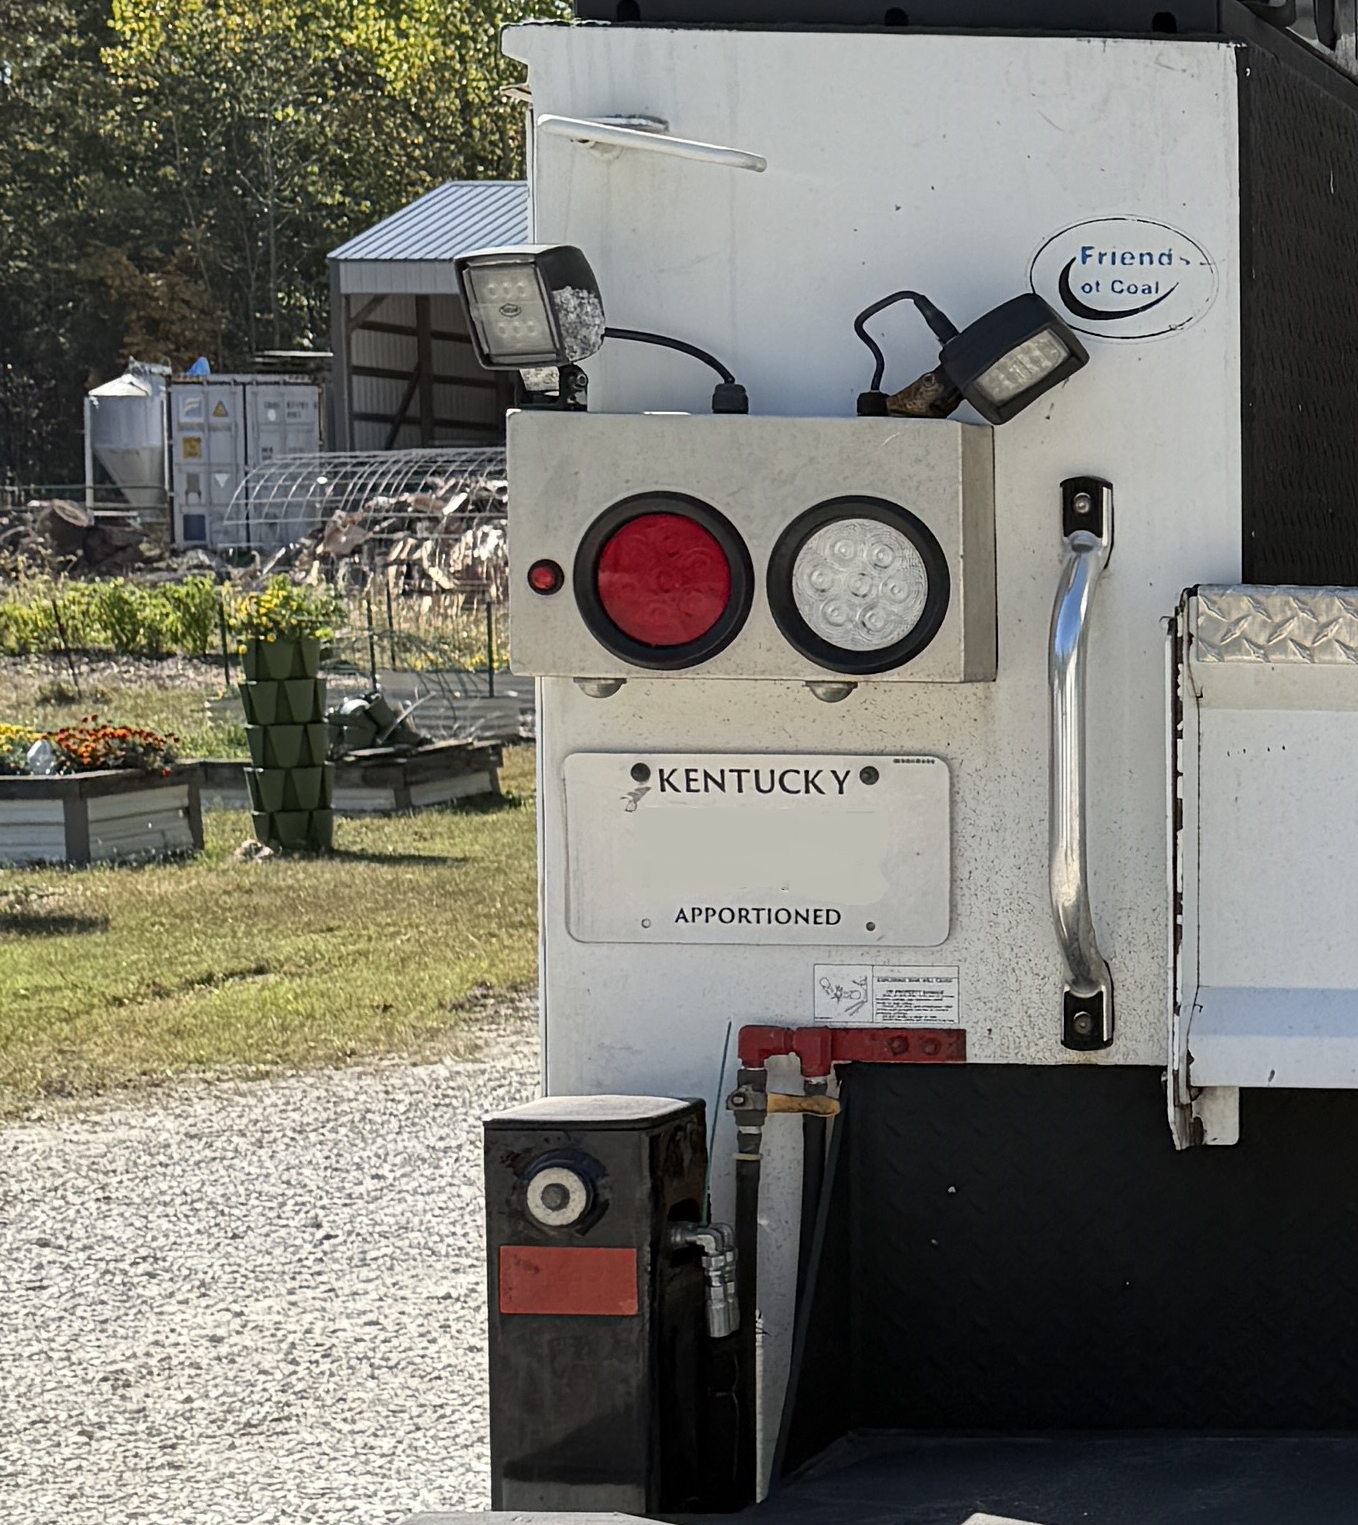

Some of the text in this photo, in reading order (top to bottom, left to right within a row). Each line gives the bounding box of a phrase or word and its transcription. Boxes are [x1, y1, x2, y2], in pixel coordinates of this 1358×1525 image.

[1111, 280, 1159, 294] Coal
[658, 768, 851, 795] KENTUCKY
[675, 906, 842, 927] APPORTIONED
